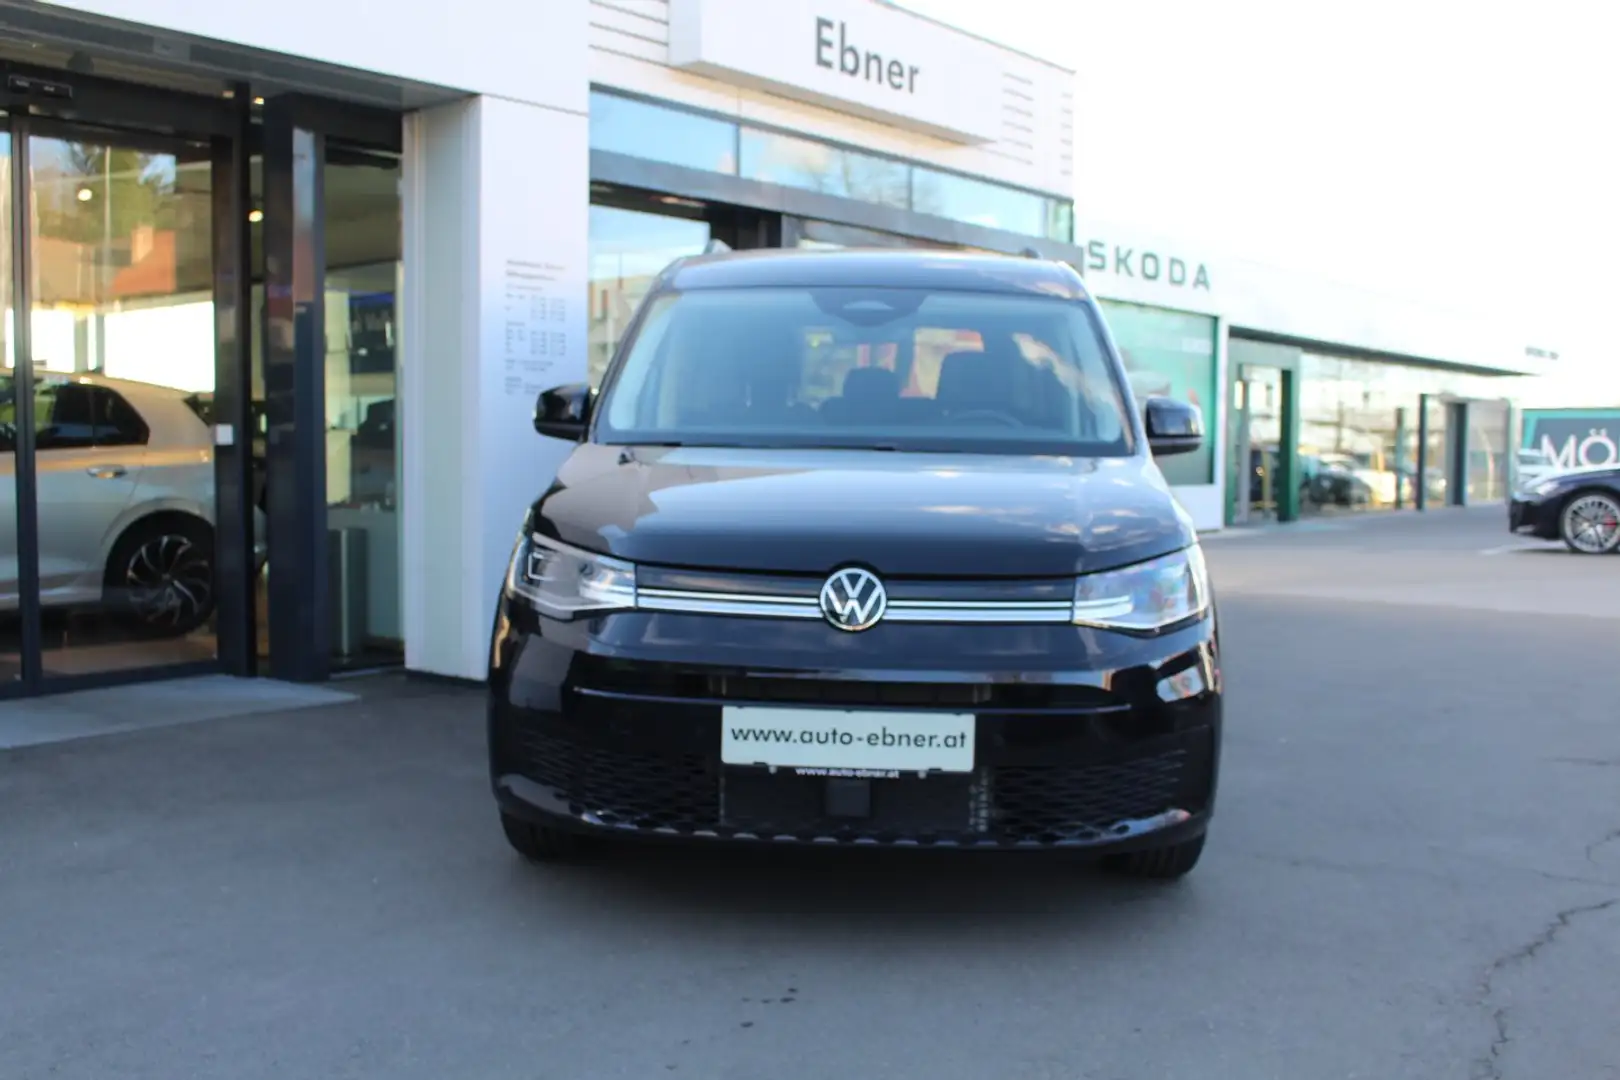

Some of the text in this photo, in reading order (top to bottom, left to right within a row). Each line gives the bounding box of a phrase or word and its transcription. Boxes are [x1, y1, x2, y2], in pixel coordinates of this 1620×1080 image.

[815, 16, 920, 94] Ebner
[1088, 240, 1210, 291] SKODA
[1541, 427, 1620, 471] MÖ
[820, 567, 887, 632] VW
[731, 726, 967, 749] www.auto-ebner.at
